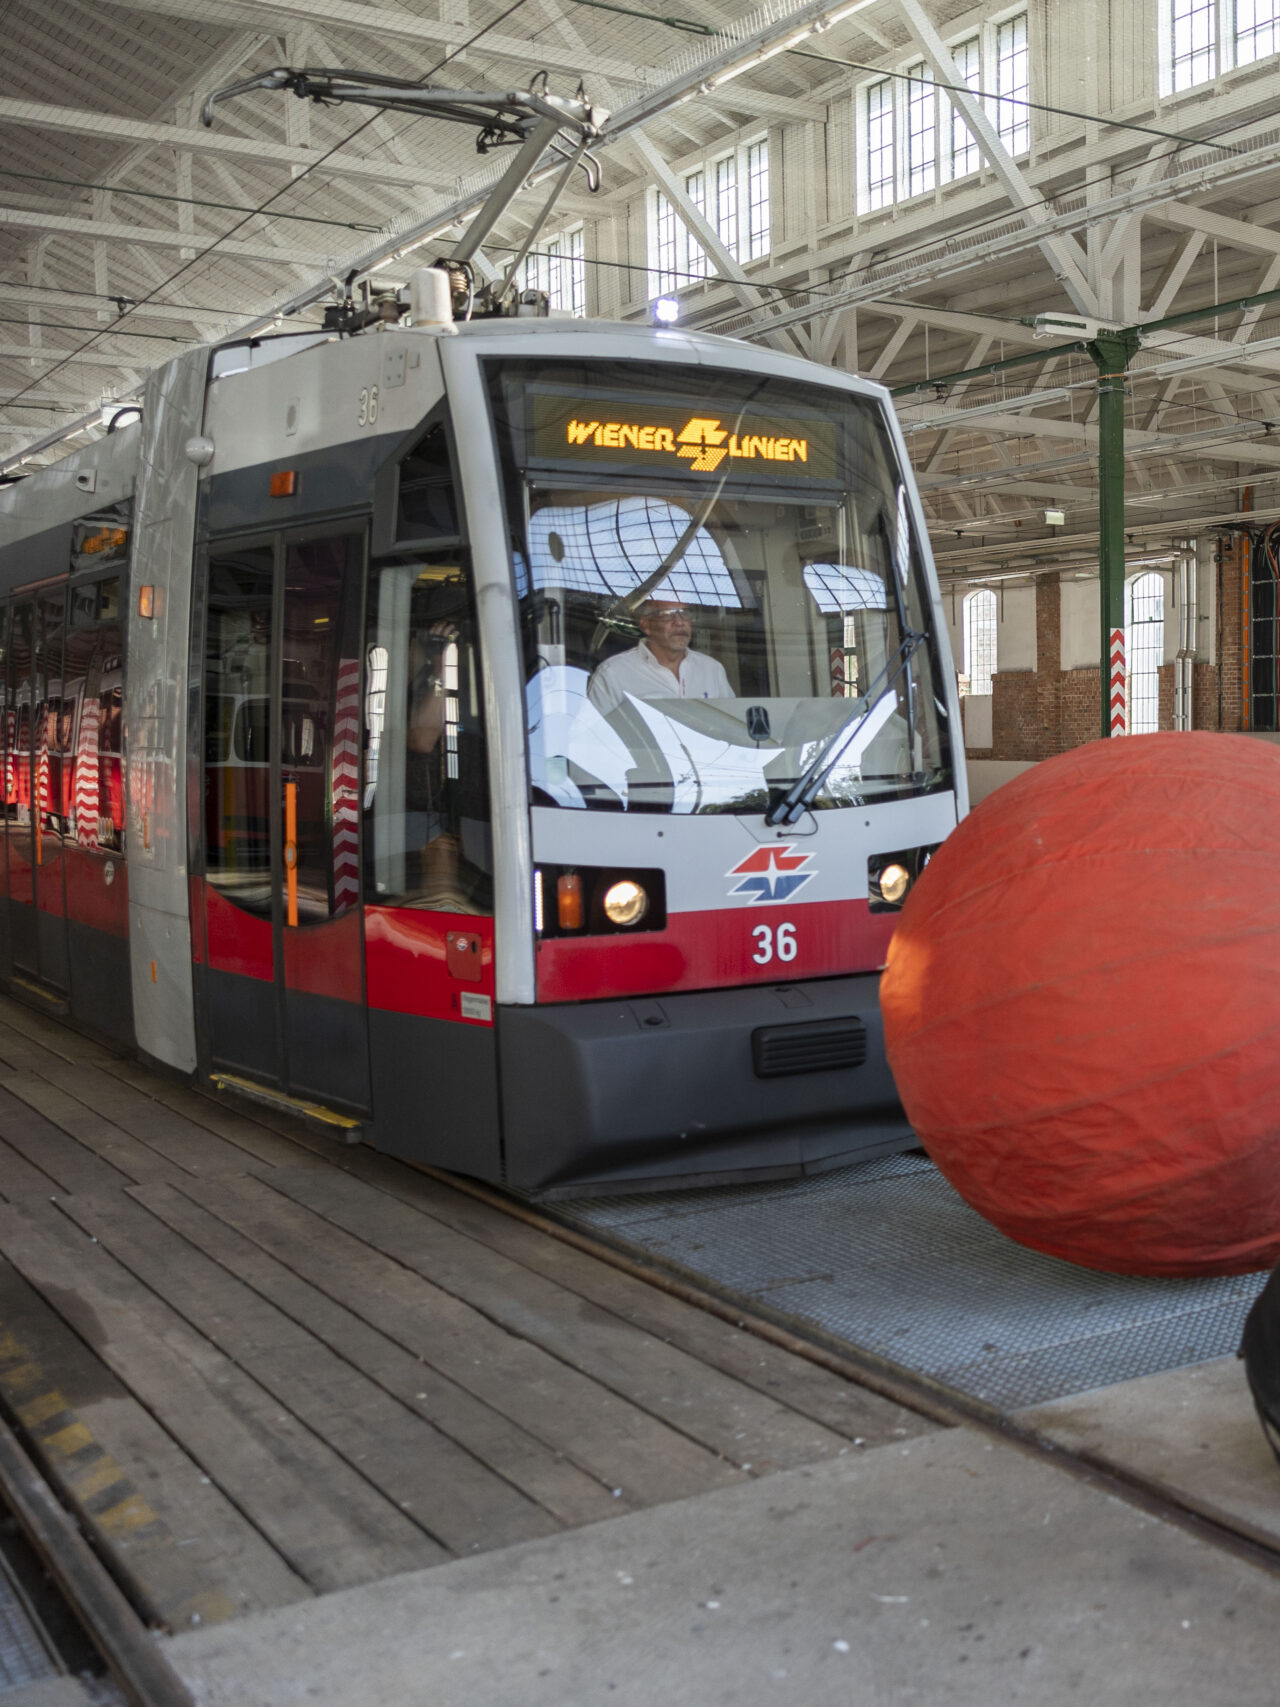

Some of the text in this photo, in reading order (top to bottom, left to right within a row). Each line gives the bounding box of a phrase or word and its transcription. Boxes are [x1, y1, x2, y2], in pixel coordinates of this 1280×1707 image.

[358, 386, 378, 426] 36
[567, 419, 808, 462] WIENER LINIEN
[752, 922, 798, 965] 36
